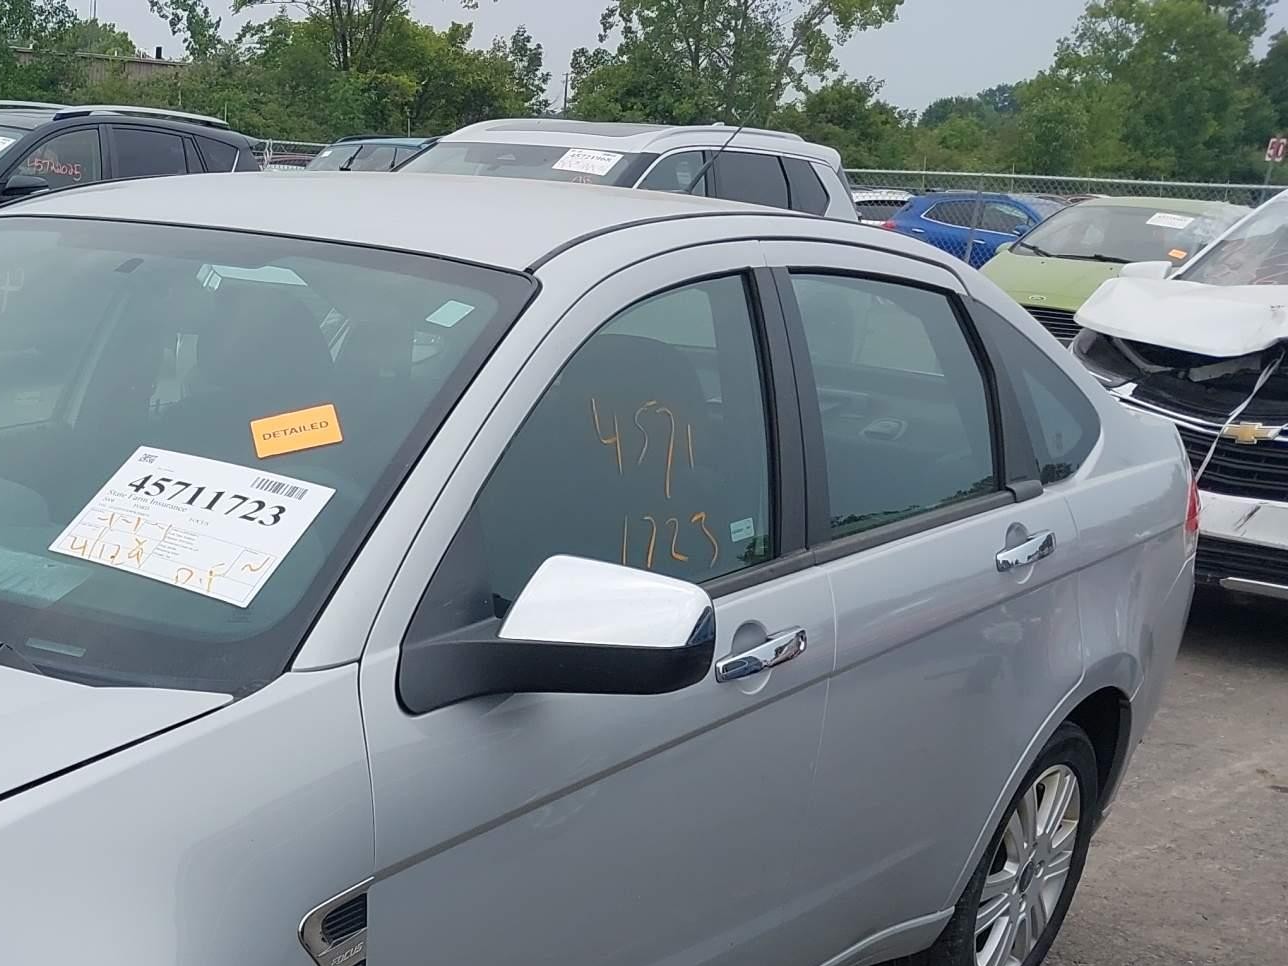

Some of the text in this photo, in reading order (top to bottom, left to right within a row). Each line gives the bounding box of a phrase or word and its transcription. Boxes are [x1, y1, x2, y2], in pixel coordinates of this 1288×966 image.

[262, 420, 330, 441] DETAILED
[128, 474, 287, 527] 45711723
[149, 498, 188, 513] Insurance
